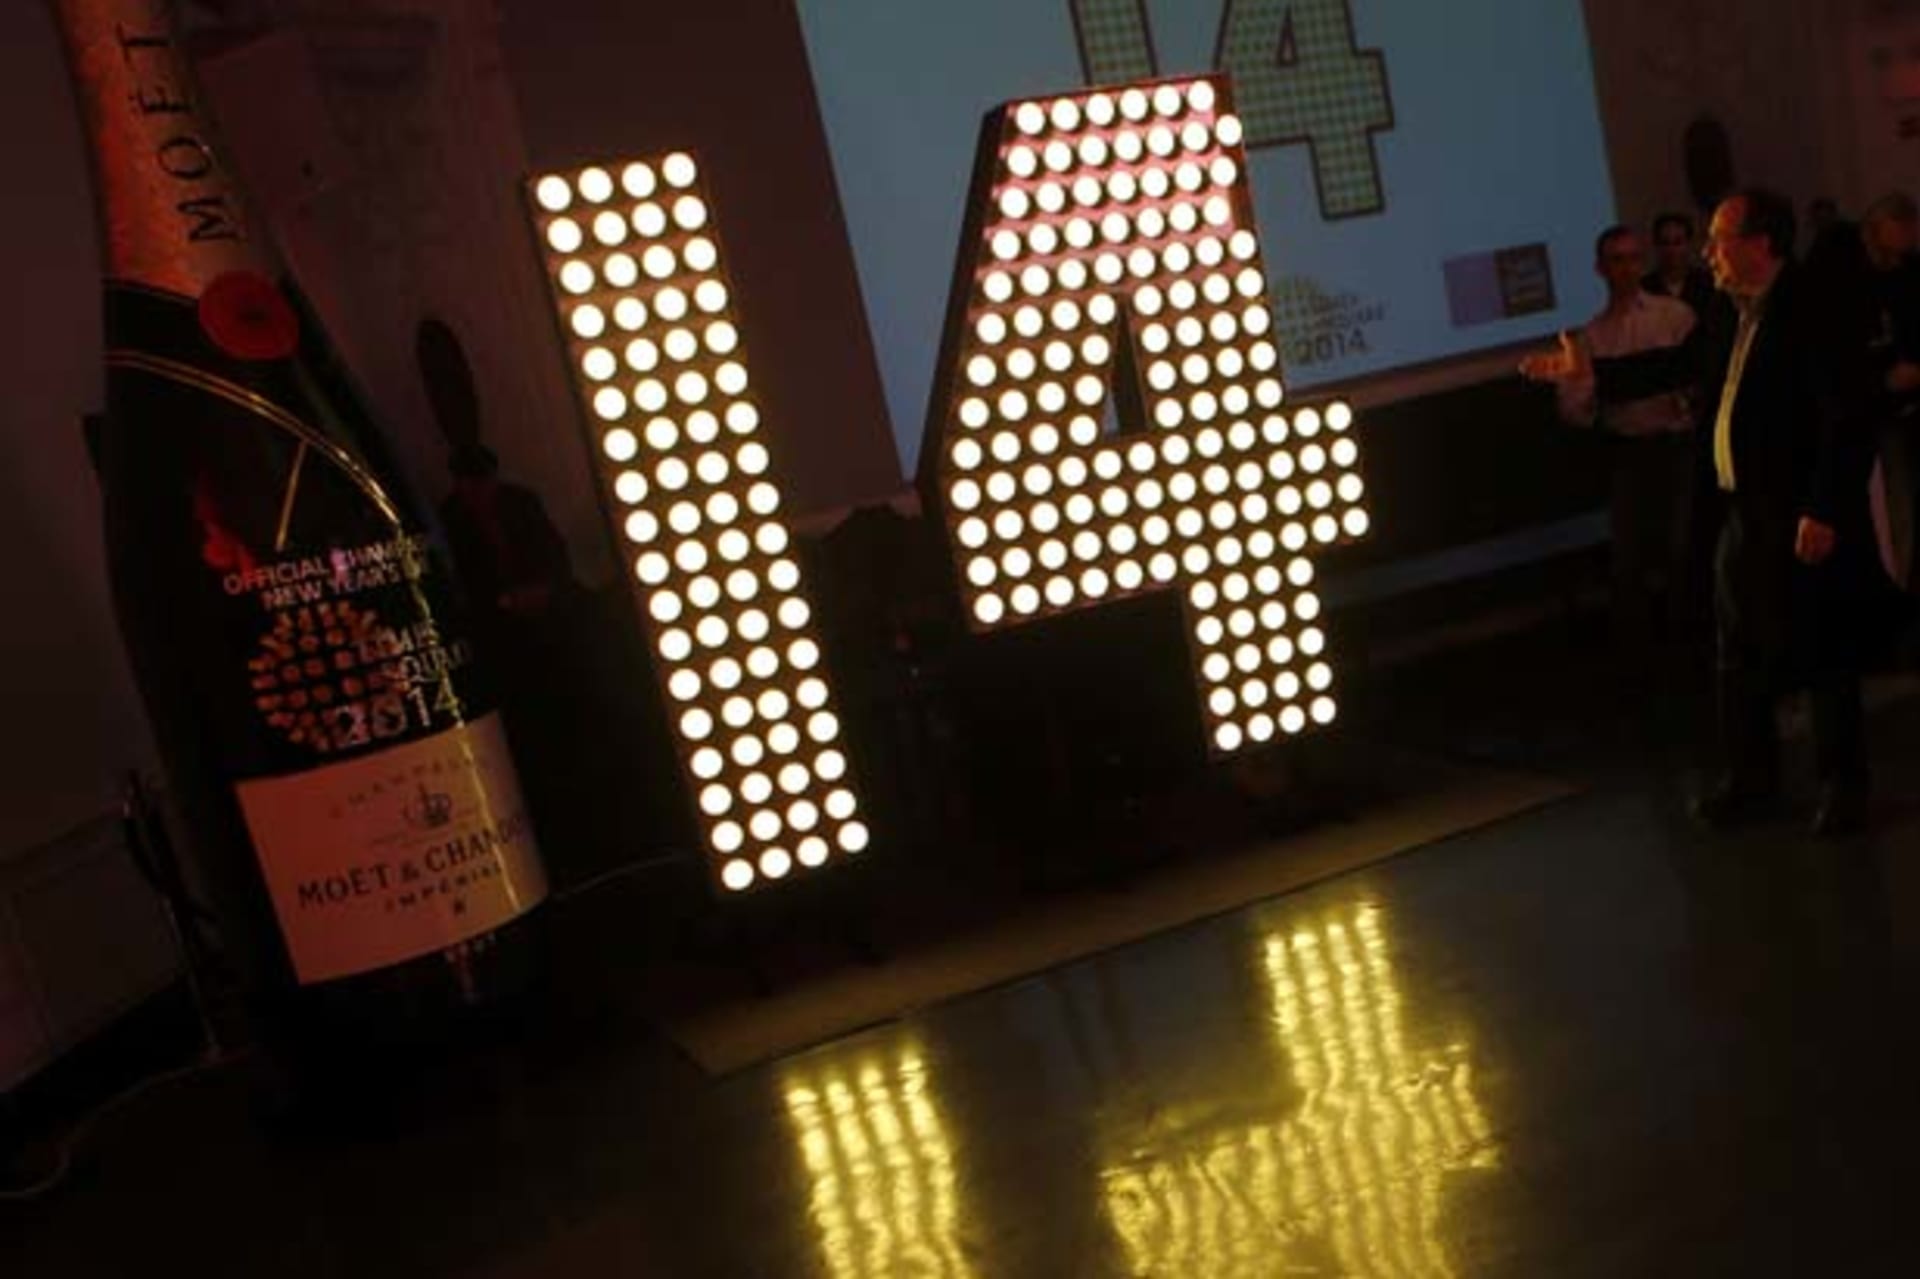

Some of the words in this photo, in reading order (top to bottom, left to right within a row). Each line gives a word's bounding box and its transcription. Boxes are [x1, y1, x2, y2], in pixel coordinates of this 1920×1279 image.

[223, 556, 329, 596] OFFICIAL
[260, 580, 323, 609] NEW
[333, 676, 464, 750] 2014
